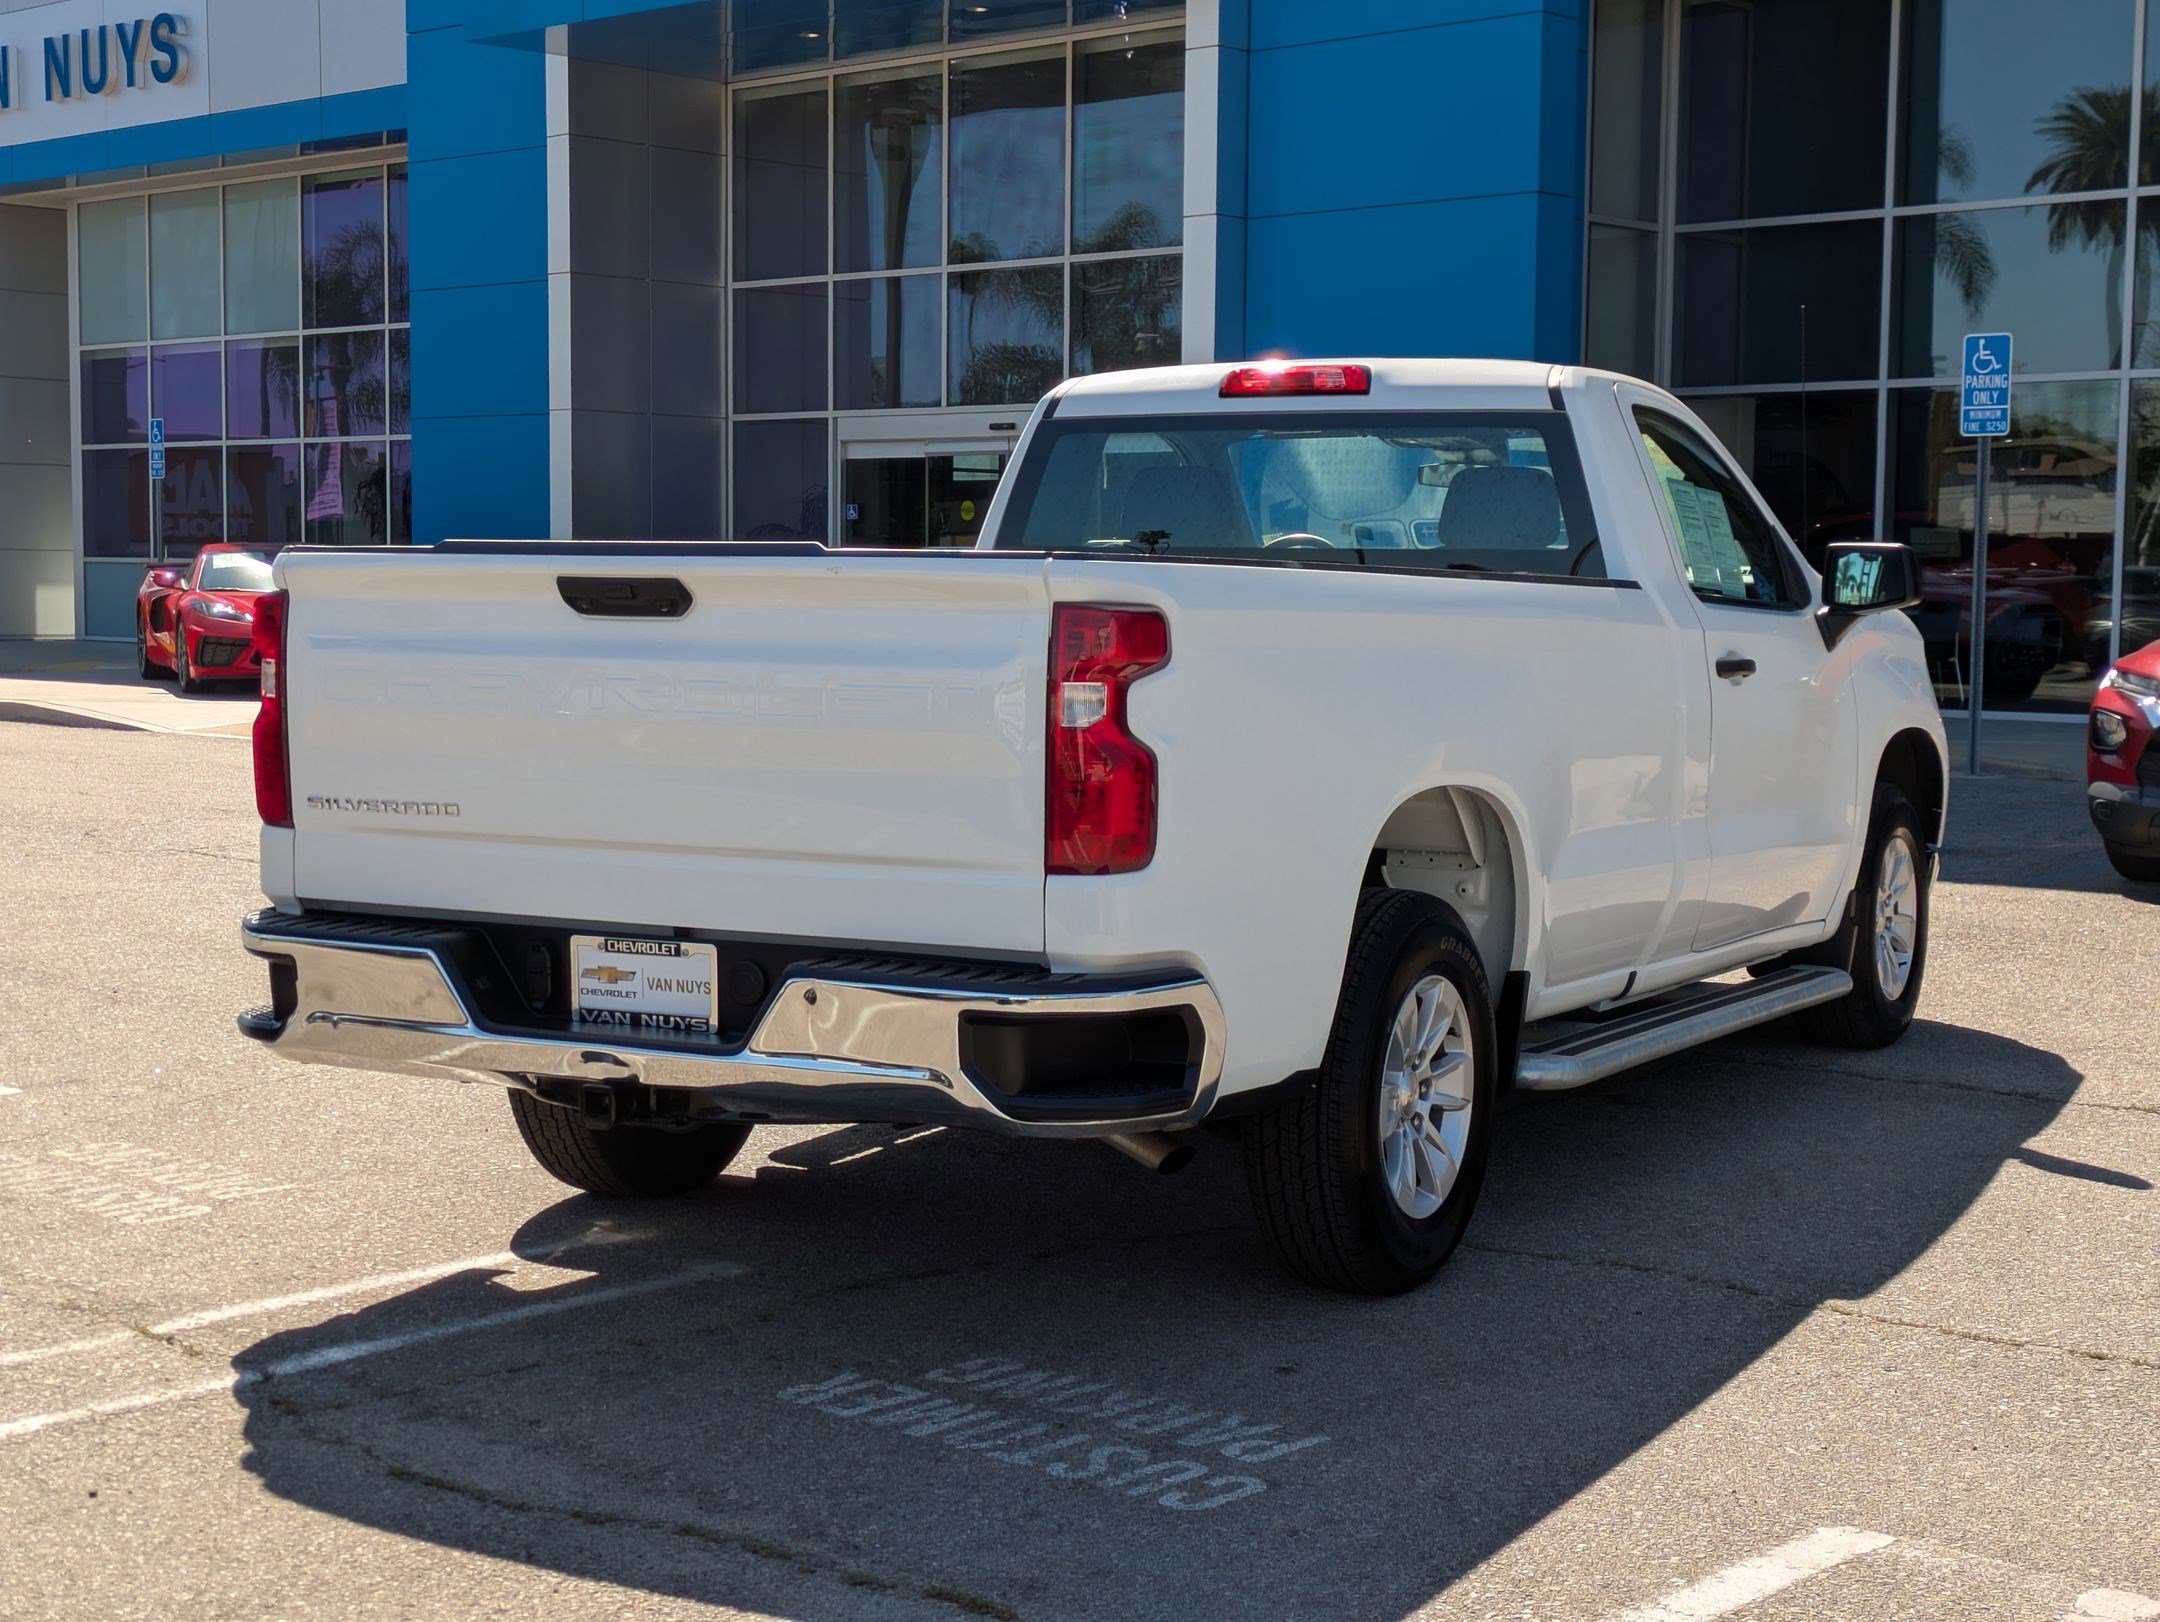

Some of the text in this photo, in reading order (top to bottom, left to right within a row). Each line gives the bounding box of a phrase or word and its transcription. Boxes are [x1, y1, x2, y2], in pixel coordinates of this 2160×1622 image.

[43, 12, 182, 101] NUYS
[1965, 374, 2008, 389] PARKING
[1972, 390, 2000, 405] ONLY
[1969, 409, 2002, 420] MINIMUM
[1964, 421, 1980, 432] FINE
[307, 796, 460, 816] SILVERADO
[607, 940, 677, 955] CHEVROLET
[580, 987, 638, 999] CHEVROLET
[646, 976, 712, 995] VAN NUYS
[580, 1008, 708, 1032] VAN NUYS
